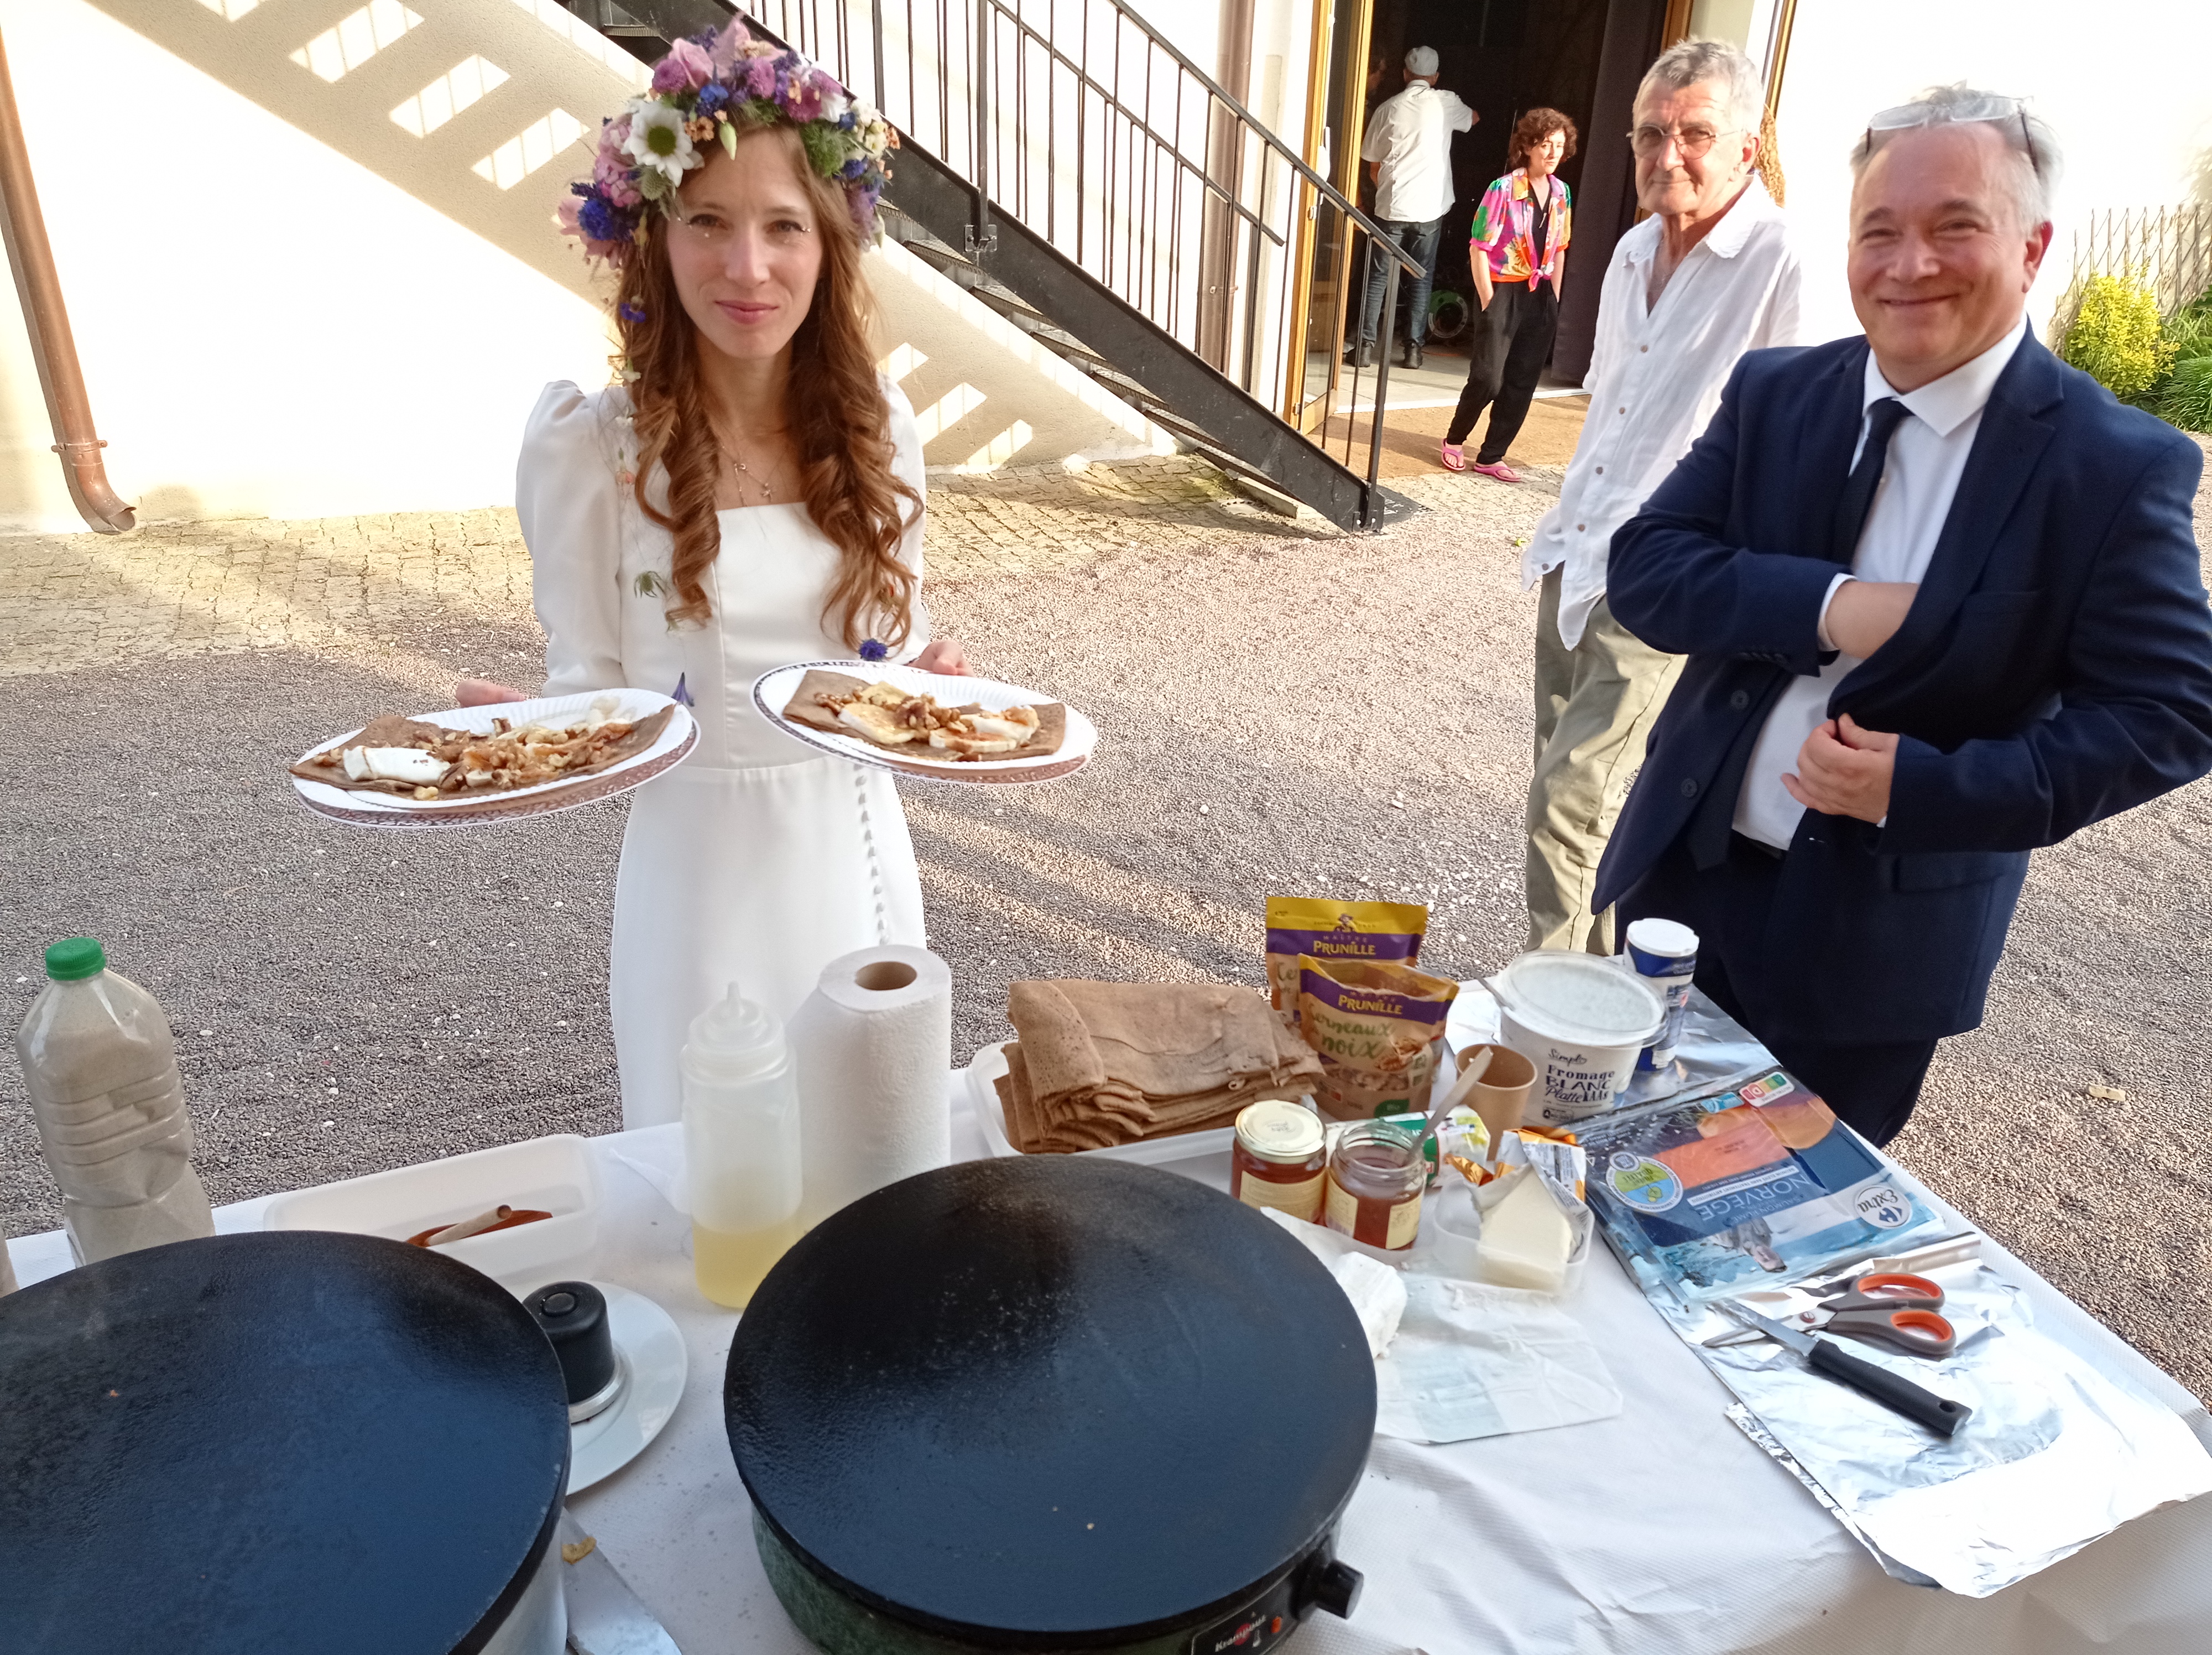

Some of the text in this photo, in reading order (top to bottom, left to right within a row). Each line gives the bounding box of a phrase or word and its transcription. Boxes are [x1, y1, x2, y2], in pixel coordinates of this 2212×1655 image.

[1322, 1037, 1383, 1059] noix
[1548, 1064, 1615, 1081] Fromage
[1546, 1075, 1611, 1091] BLANC
[1545, 1086, 1583, 1103] Platte
[1695, 1173, 1811, 1221] NORVÈGE
[1857, 1189, 1898, 1212] Extra
